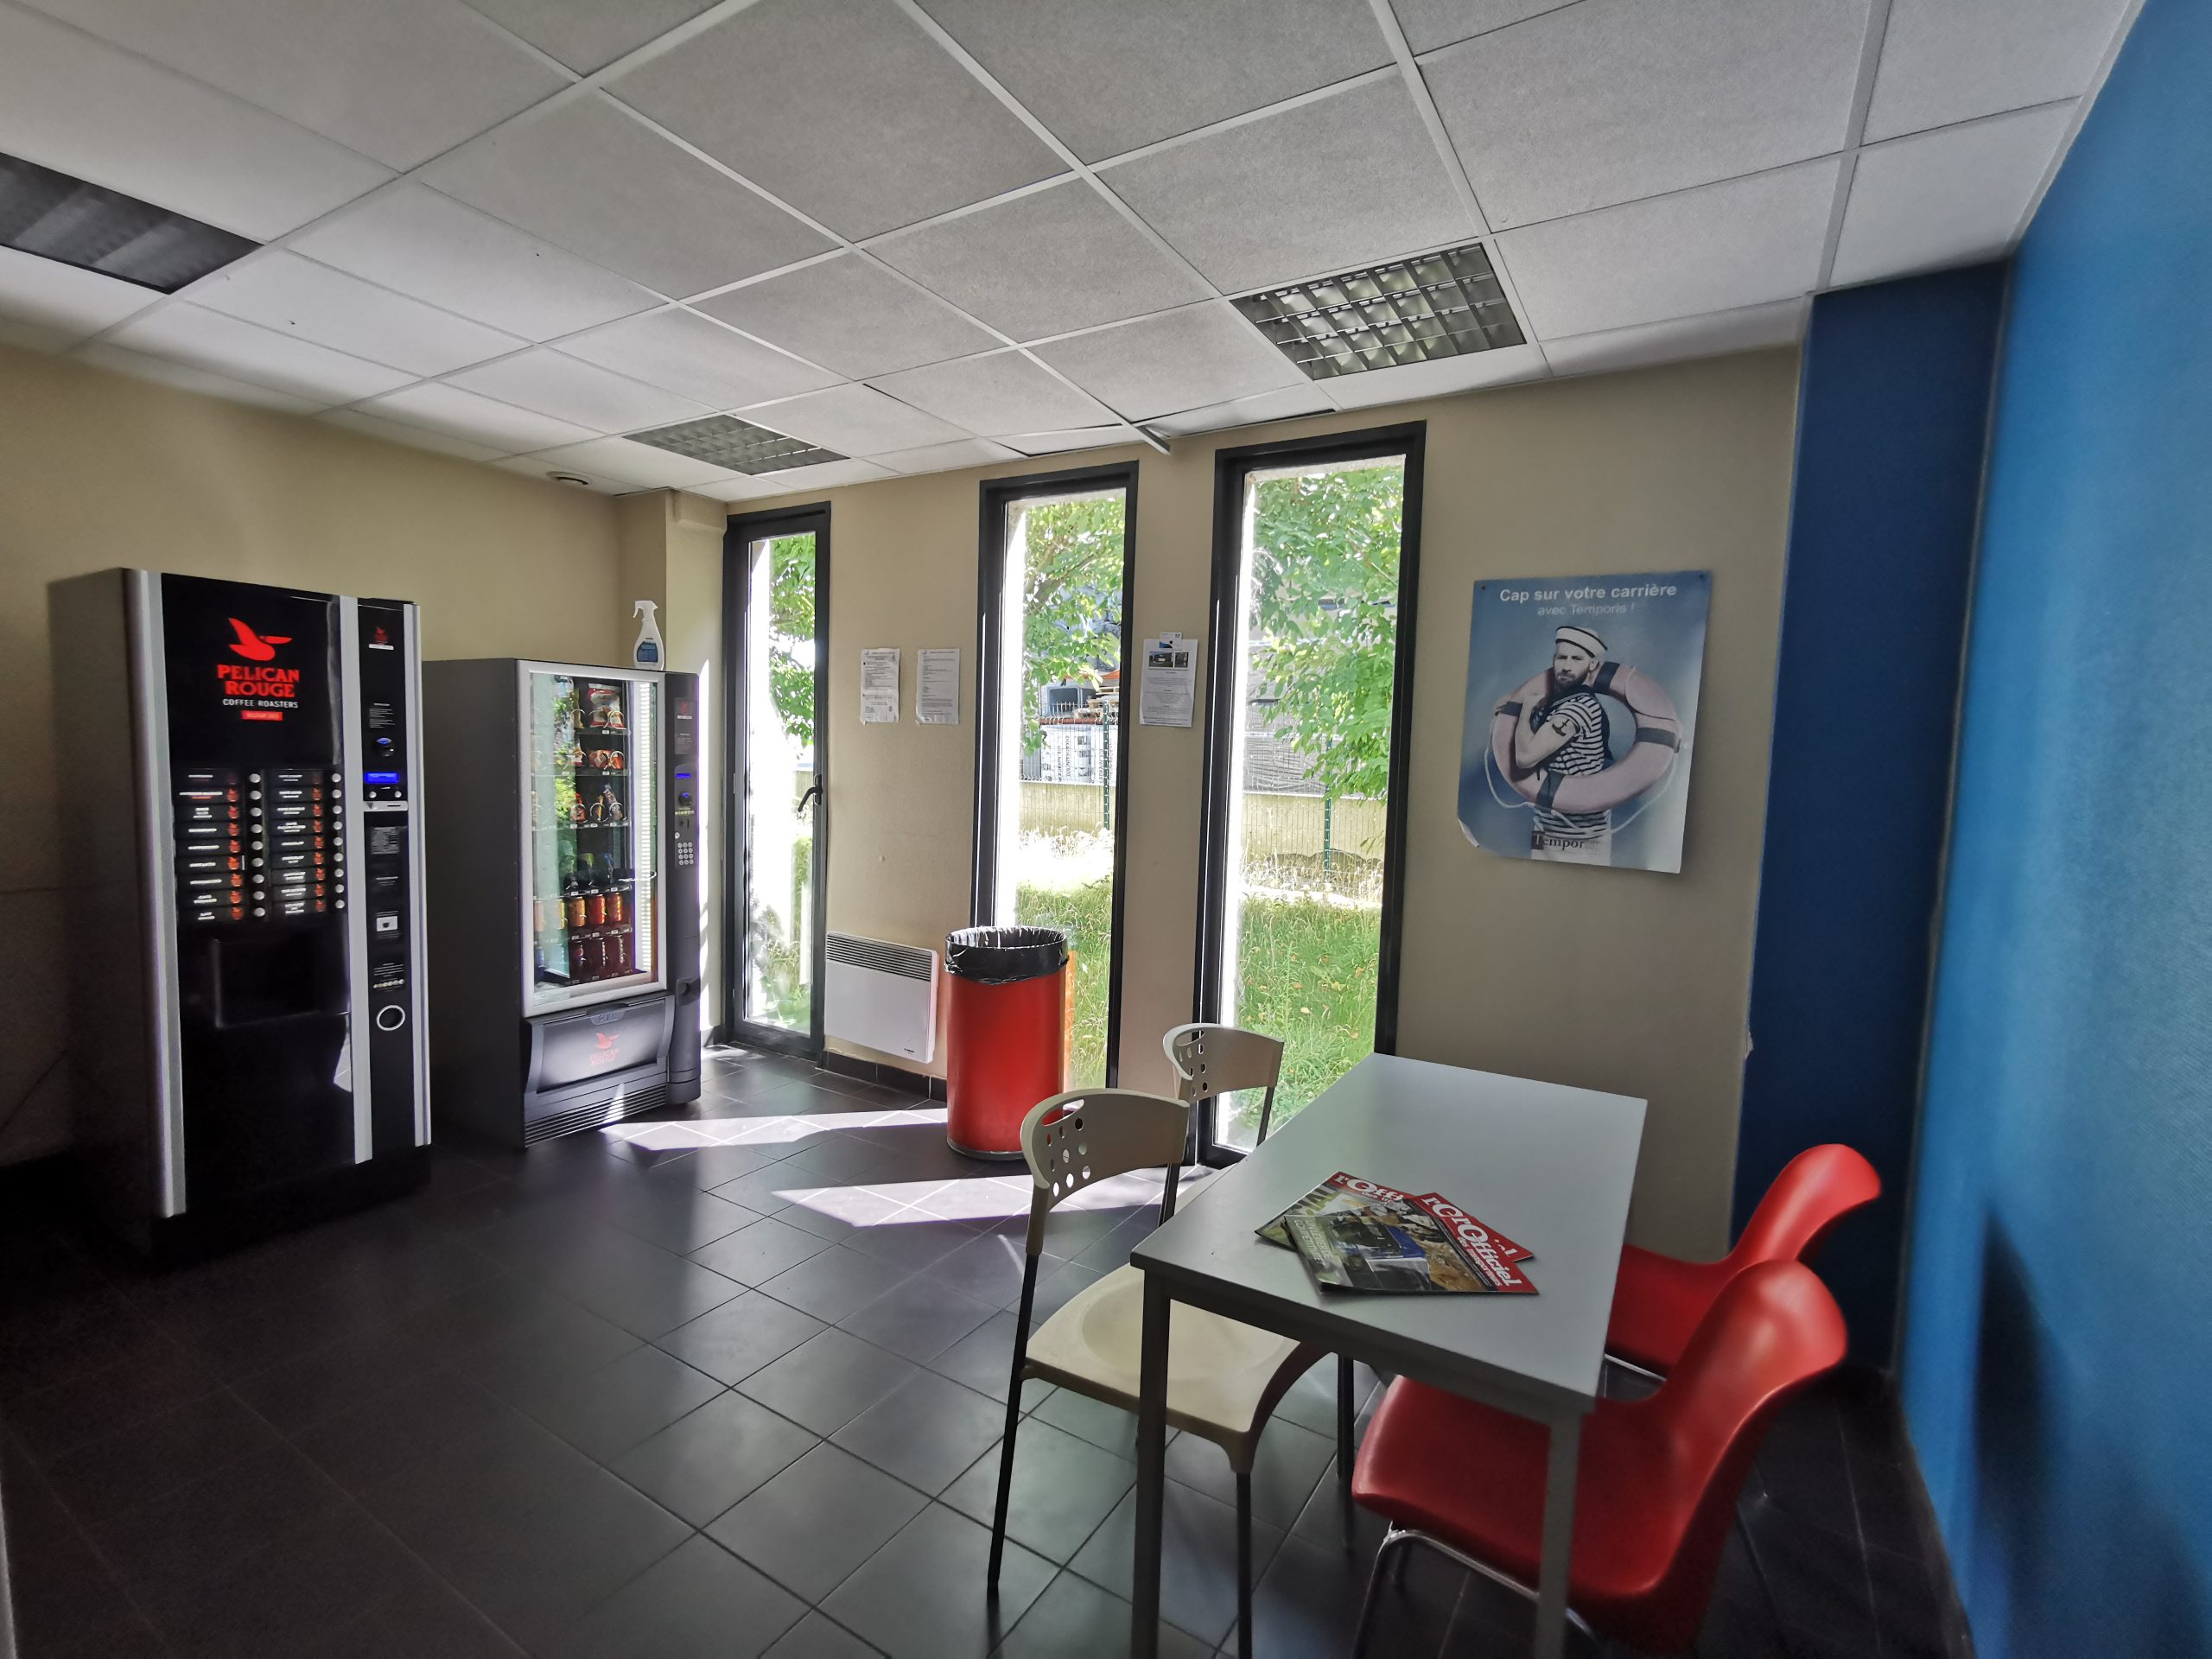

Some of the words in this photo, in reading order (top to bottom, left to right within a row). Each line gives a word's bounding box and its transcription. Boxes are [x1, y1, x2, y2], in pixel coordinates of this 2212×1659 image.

[1500, 589, 1529, 603] Cap
[1534, 589, 1559, 601] sur
[1565, 587, 1606, 600] votre
[1611, 584, 1677, 598] carrière
[1537, 607, 1566, 615] avec
[217, 664, 300, 683] PELICAN
[225, 680, 296, 697] ROUGE
[222, 698, 254, 707] COFFEE
[257, 700, 299, 709] ROASTERS
